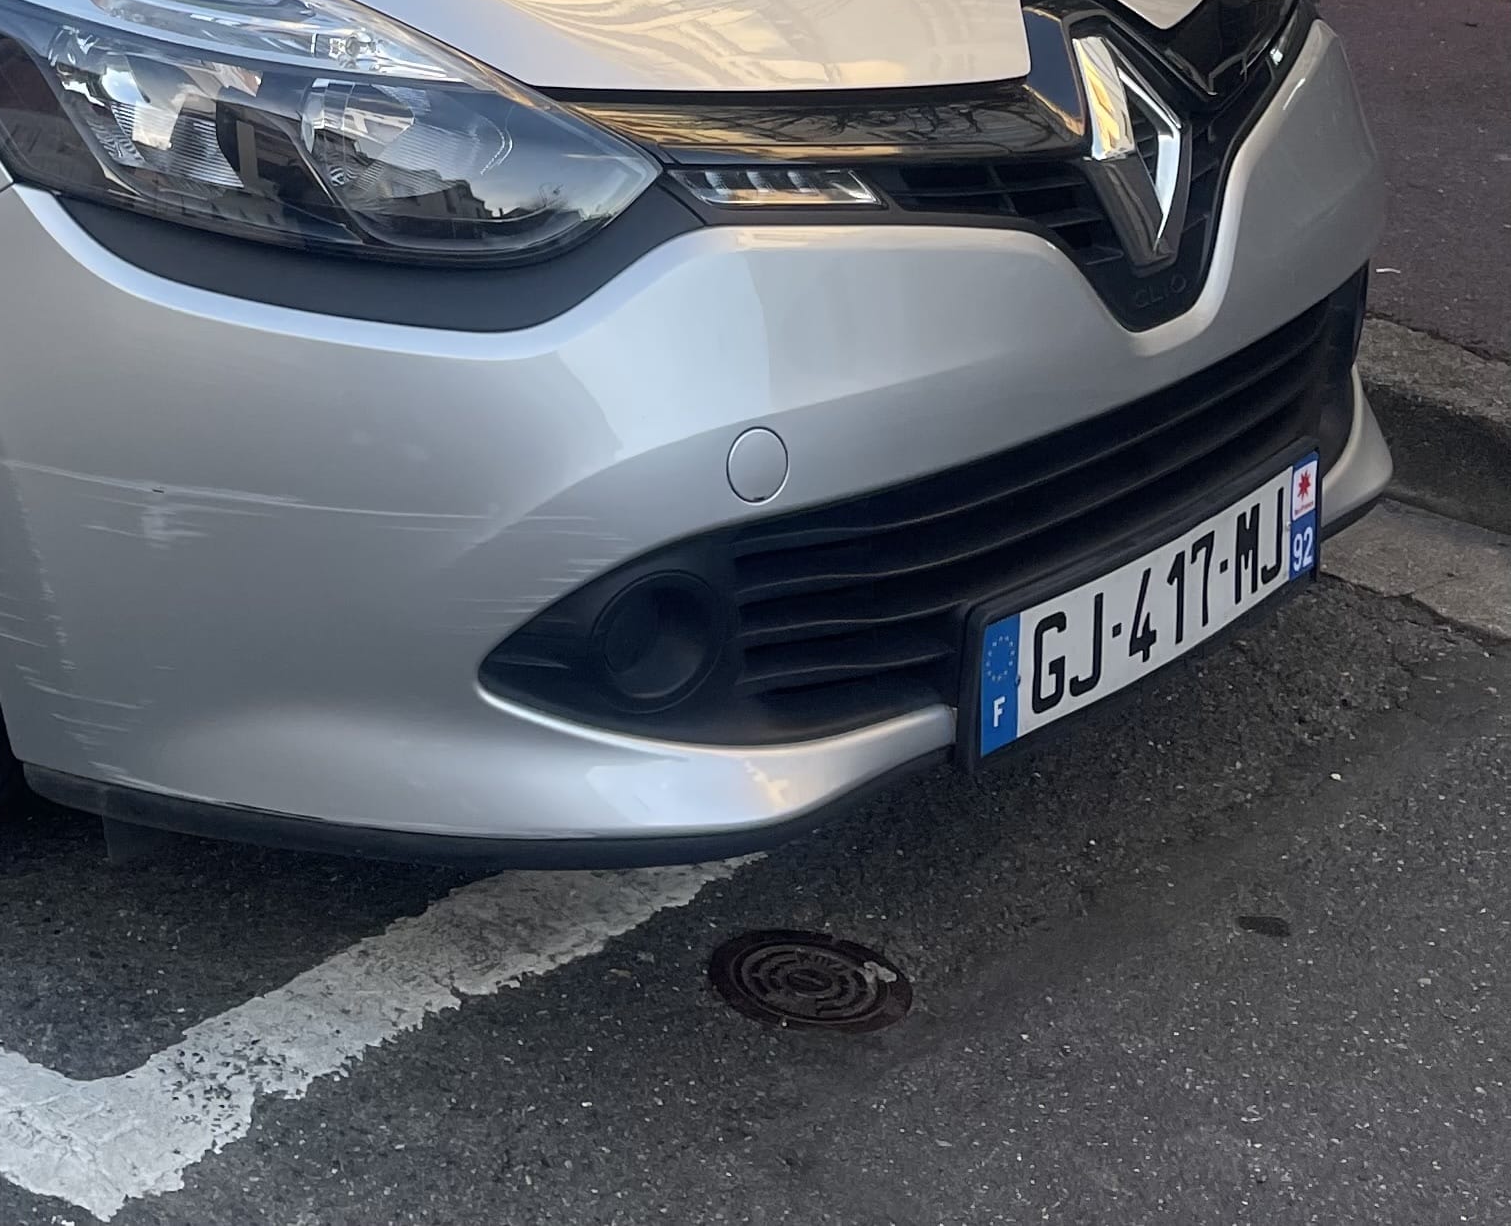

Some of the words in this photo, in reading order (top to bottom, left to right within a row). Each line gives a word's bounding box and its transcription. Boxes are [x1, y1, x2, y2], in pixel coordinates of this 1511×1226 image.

[1293, 526, 1313, 571] 92
[1031, 486, 1285, 715] GJ-417-MJ
[992, 696, 1006, 727] F
